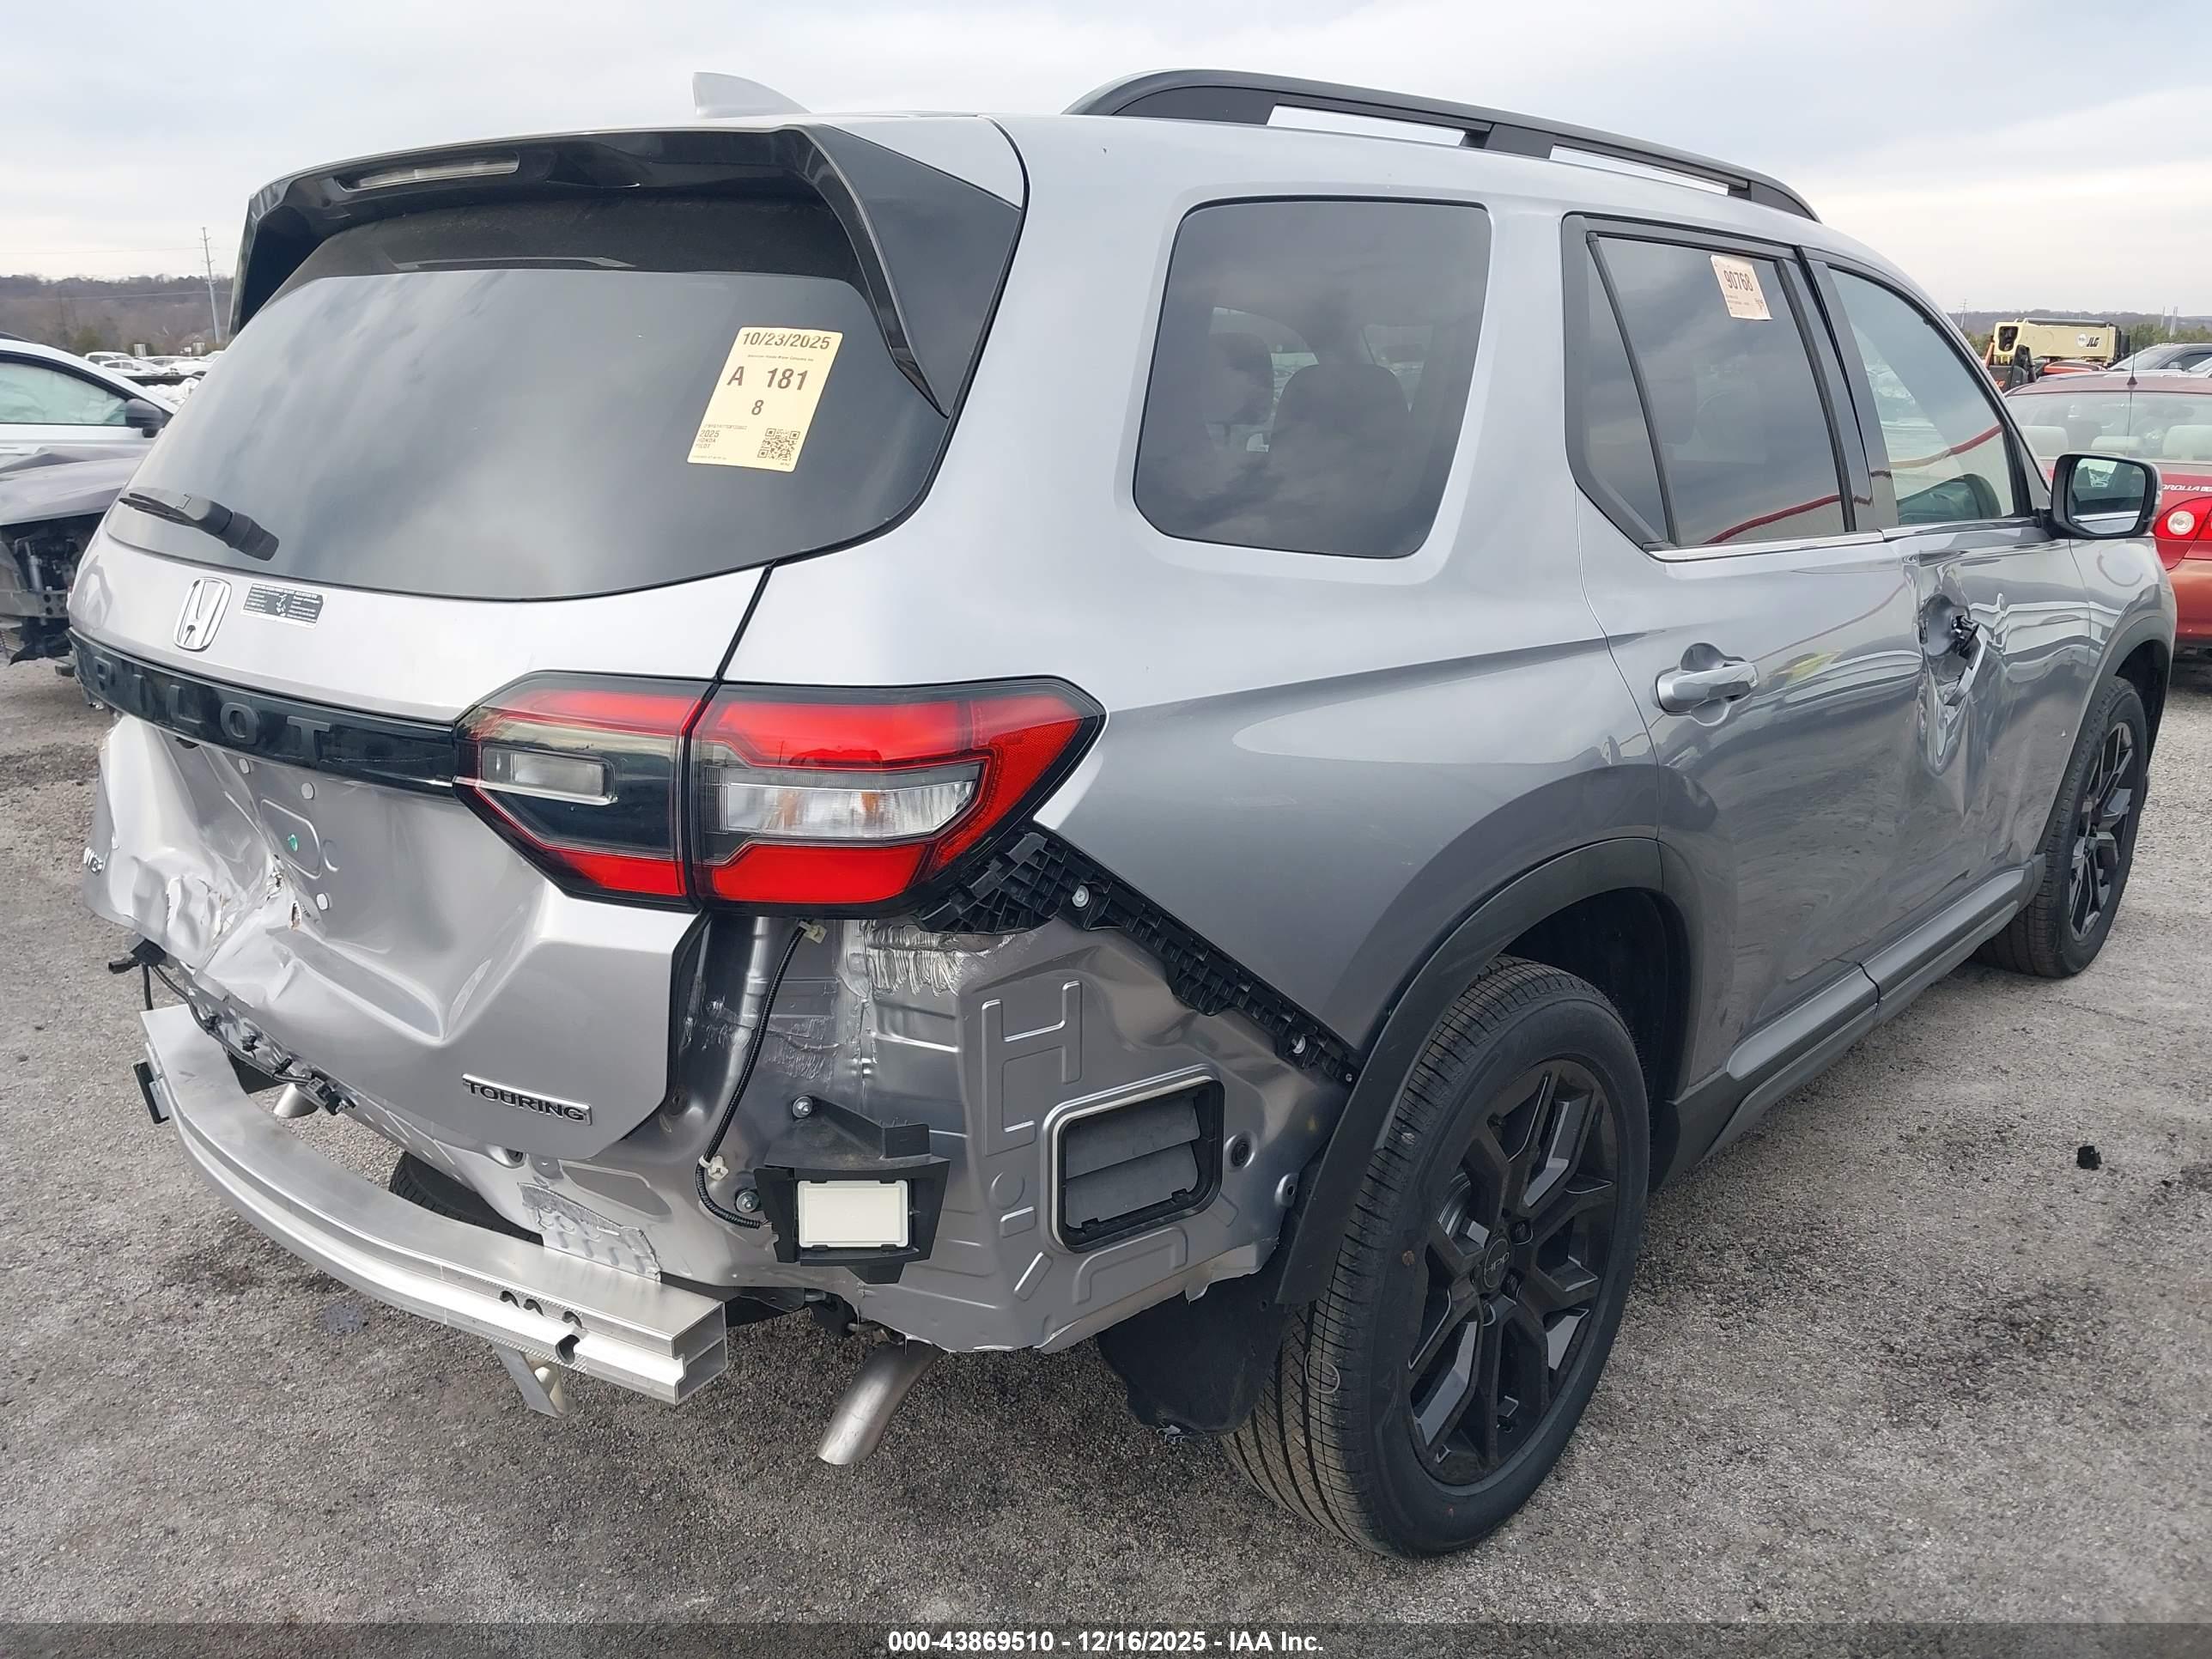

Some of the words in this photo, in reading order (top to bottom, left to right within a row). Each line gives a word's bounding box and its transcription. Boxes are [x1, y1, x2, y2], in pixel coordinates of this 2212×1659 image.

[1723, 270, 1753, 291] 90768
[743, 331, 832, 350] 10/23/2025
[726, 366, 744, 386] A
[767, 368, 809, 391] 181
[751, 399, 764, 416] 8
[699, 429, 720, 438] 2025
[94, 655, 331, 769] PILOT
[462, 1078, 586, 1121] TOURING
